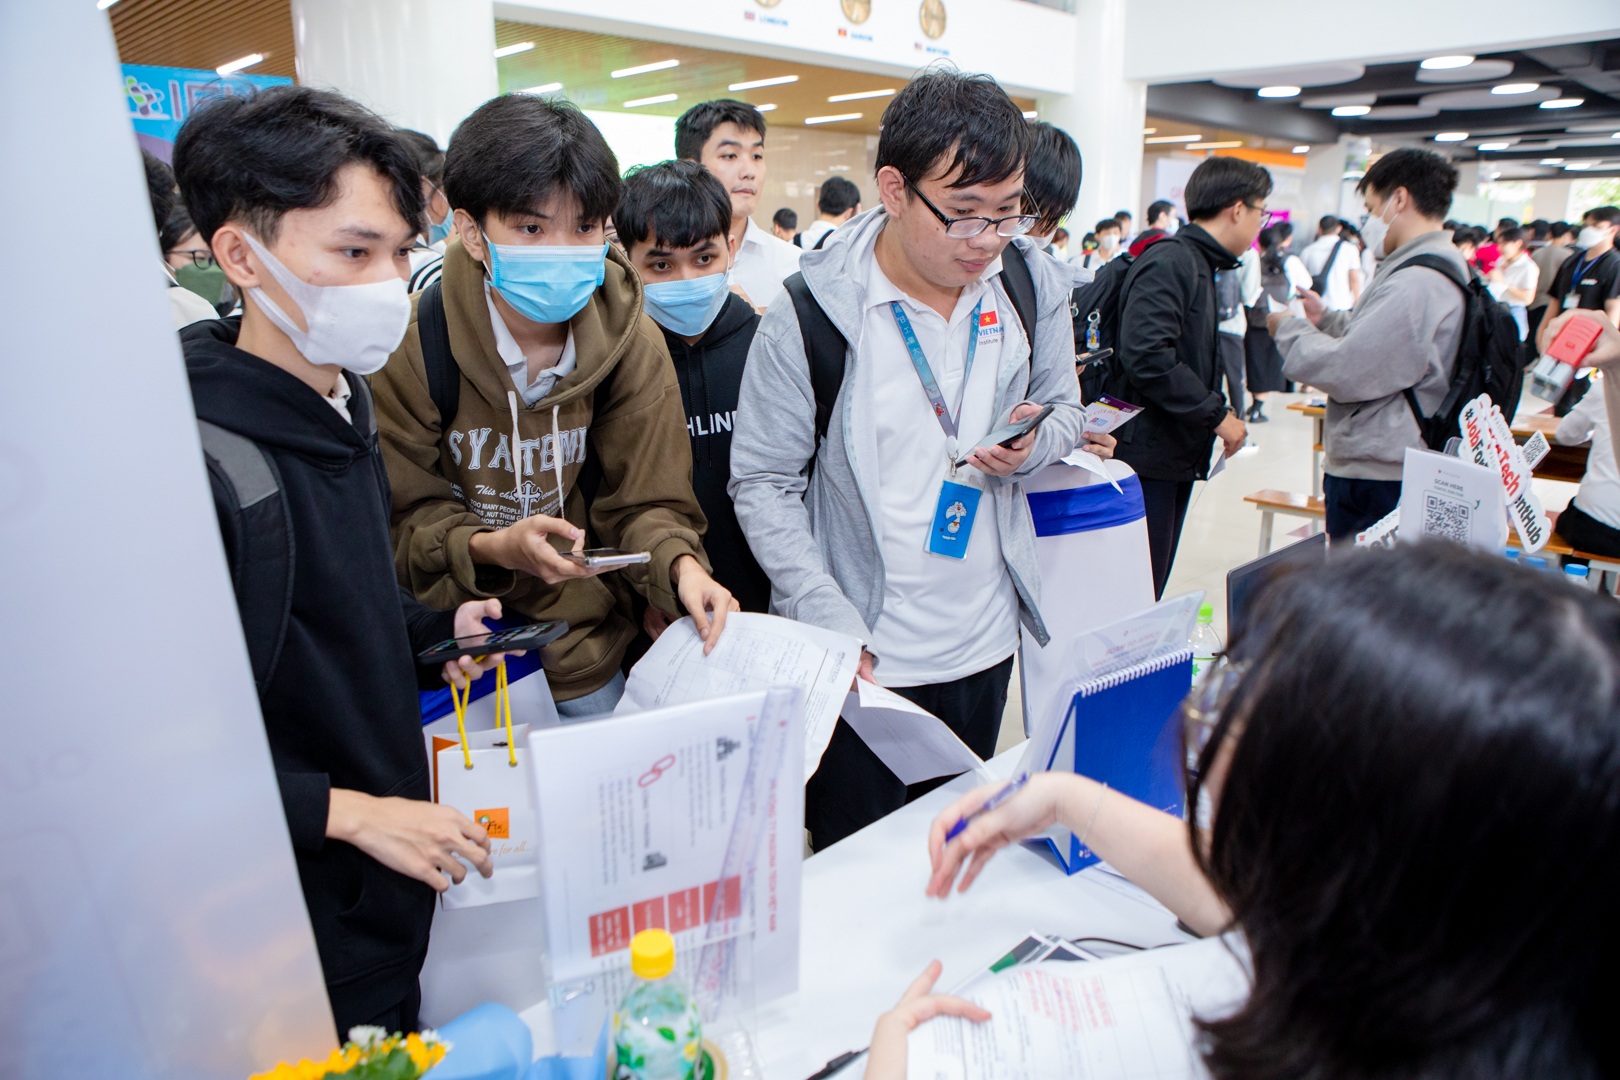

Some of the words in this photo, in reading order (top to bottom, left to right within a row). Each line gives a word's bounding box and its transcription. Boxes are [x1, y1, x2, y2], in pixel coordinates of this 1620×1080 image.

[475, 484, 496, 496] This
[482, 503, 499, 511] MANY
[499, 512, 515, 520] THEM
